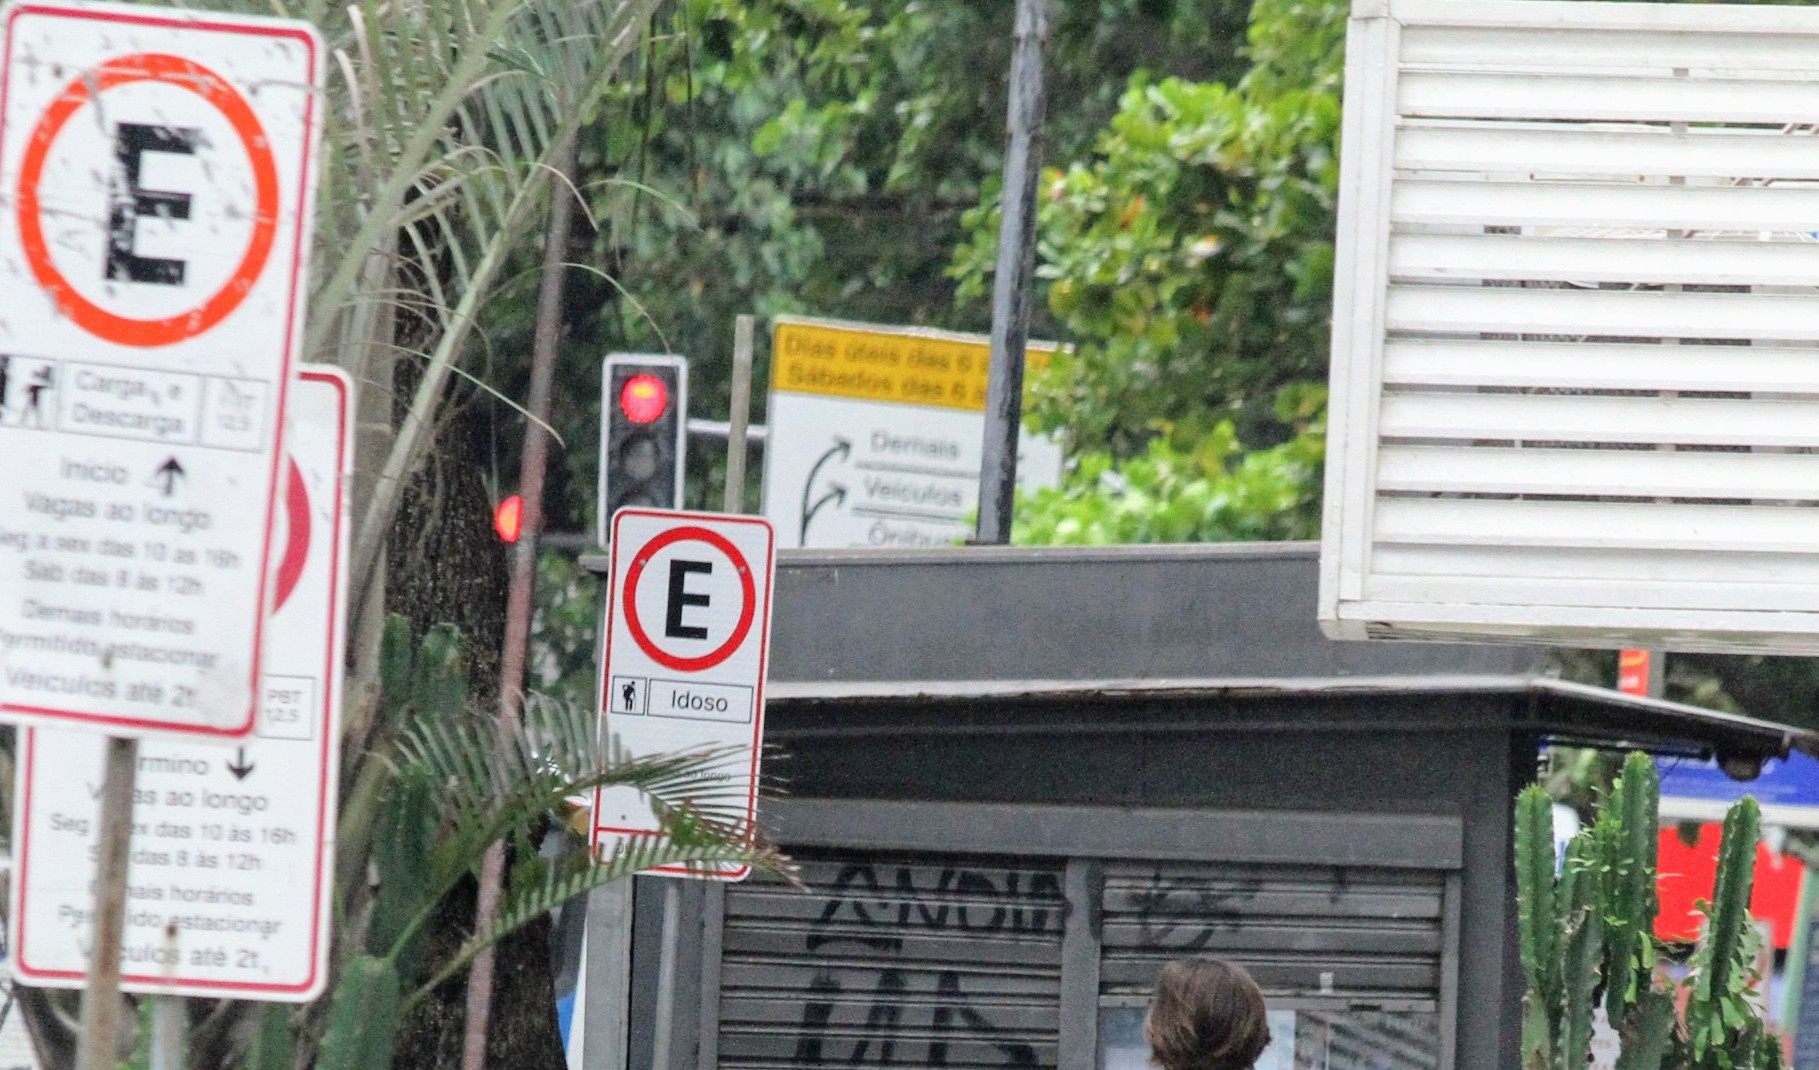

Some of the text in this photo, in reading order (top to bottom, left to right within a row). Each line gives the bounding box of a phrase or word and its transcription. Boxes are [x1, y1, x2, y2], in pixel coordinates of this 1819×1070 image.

[105, 121, 206, 285] E
[75, 370, 146, 400] Carga
[71, 403, 183, 436] Descarga
[869, 429, 960, 459] Demais
[24, 490, 212, 533] Vagas ao longo
[23, 598, 100, 625] Demais
[665, 559, 713, 640] E
[671, 689, 729, 714] Idoso
[166, 788, 193, 807] ao
[203, 787, 268, 815] longo
[50, 813, 89, 836] Seg
[154, 820, 192, 840] das
[201, 824, 223, 841] 10
[260, 827, 296, 845] 16h
[132, 849, 170, 866] das
[175, 850, 188, 867] 8
[226, 853, 262, 871] 12h
[169, 910, 281, 936] estacionar
[190, 944, 227, 967] até
[235, 948, 259, 968] 2t
